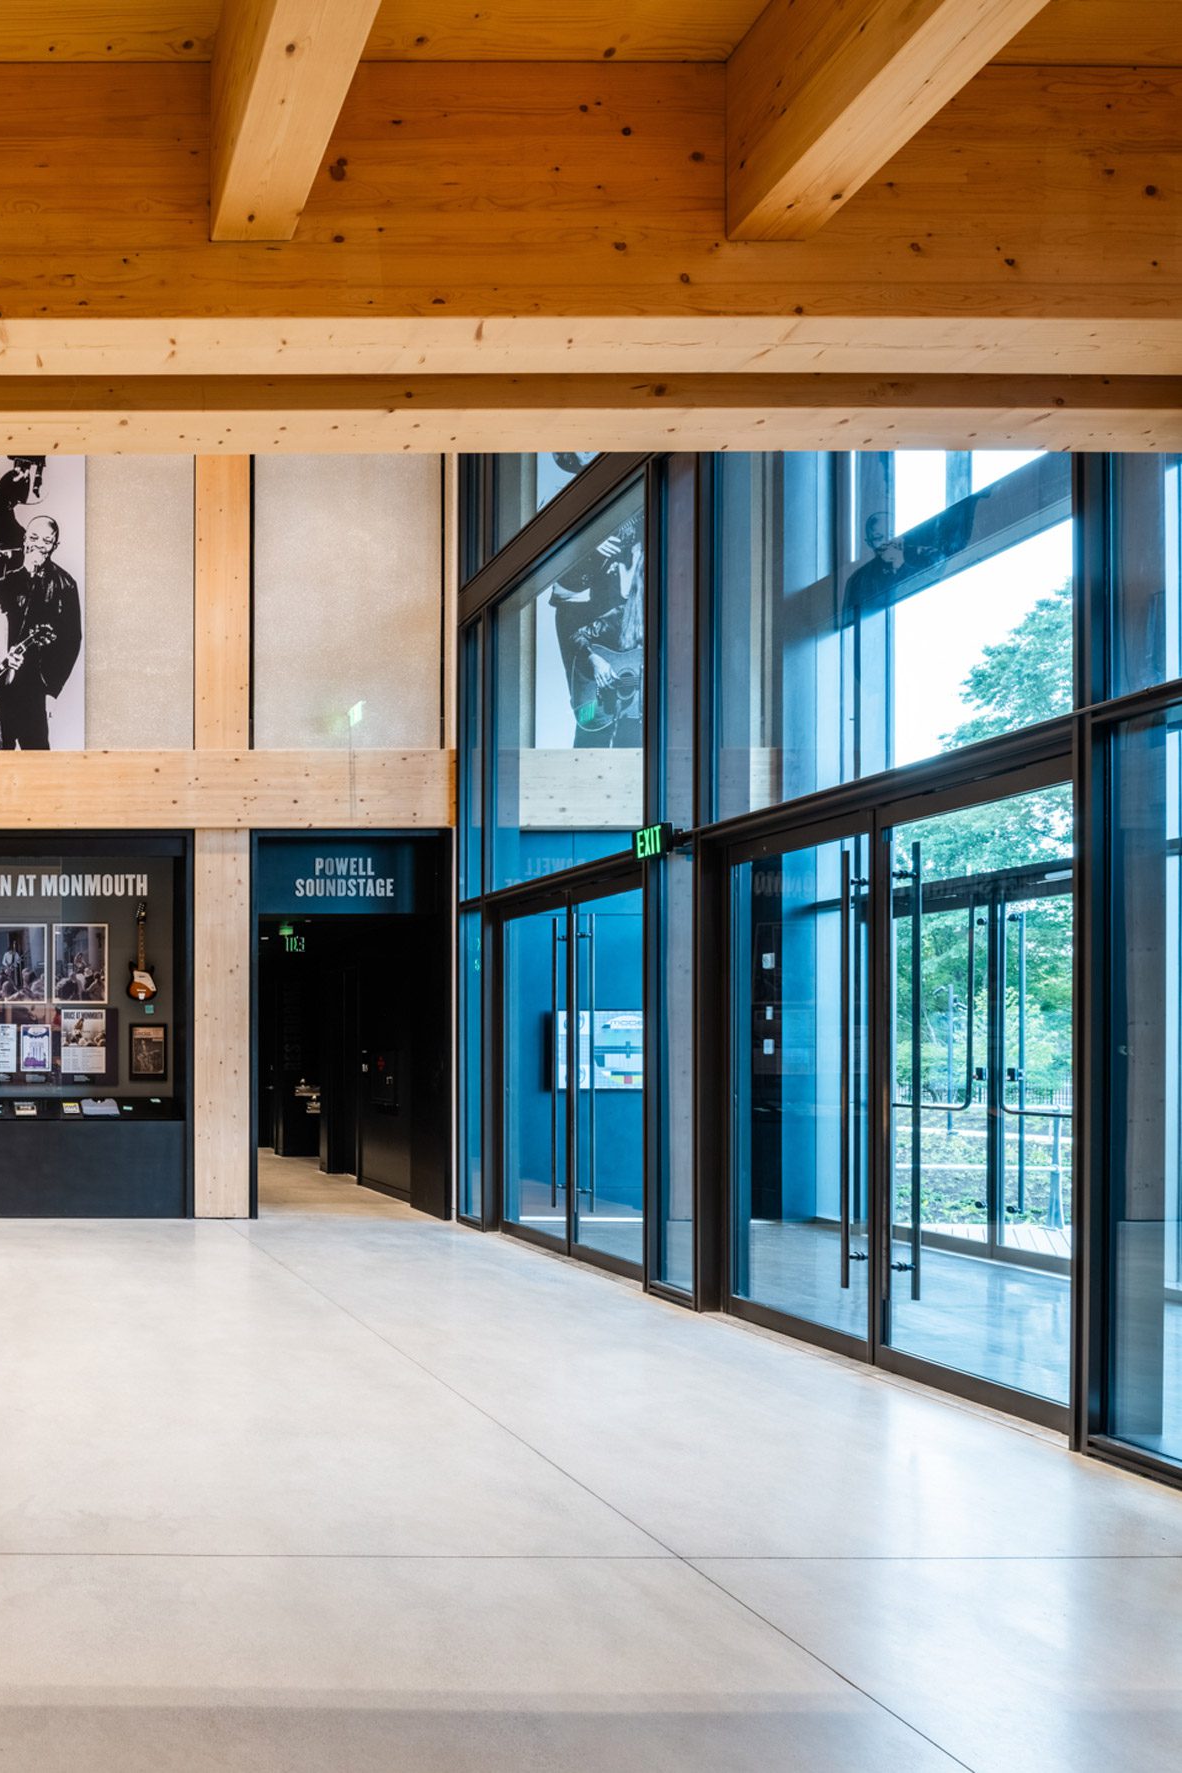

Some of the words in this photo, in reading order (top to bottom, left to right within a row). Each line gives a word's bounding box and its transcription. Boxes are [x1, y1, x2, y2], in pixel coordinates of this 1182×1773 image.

[636, 825, 662, 859] EXIT
[314, 857, 375, 876] POWELL
[16, 874, 36, 897] AT
[40, 874, 148, 897] MONMOUTH
[294, 878, 395, 897] SOUNDSTAGE
